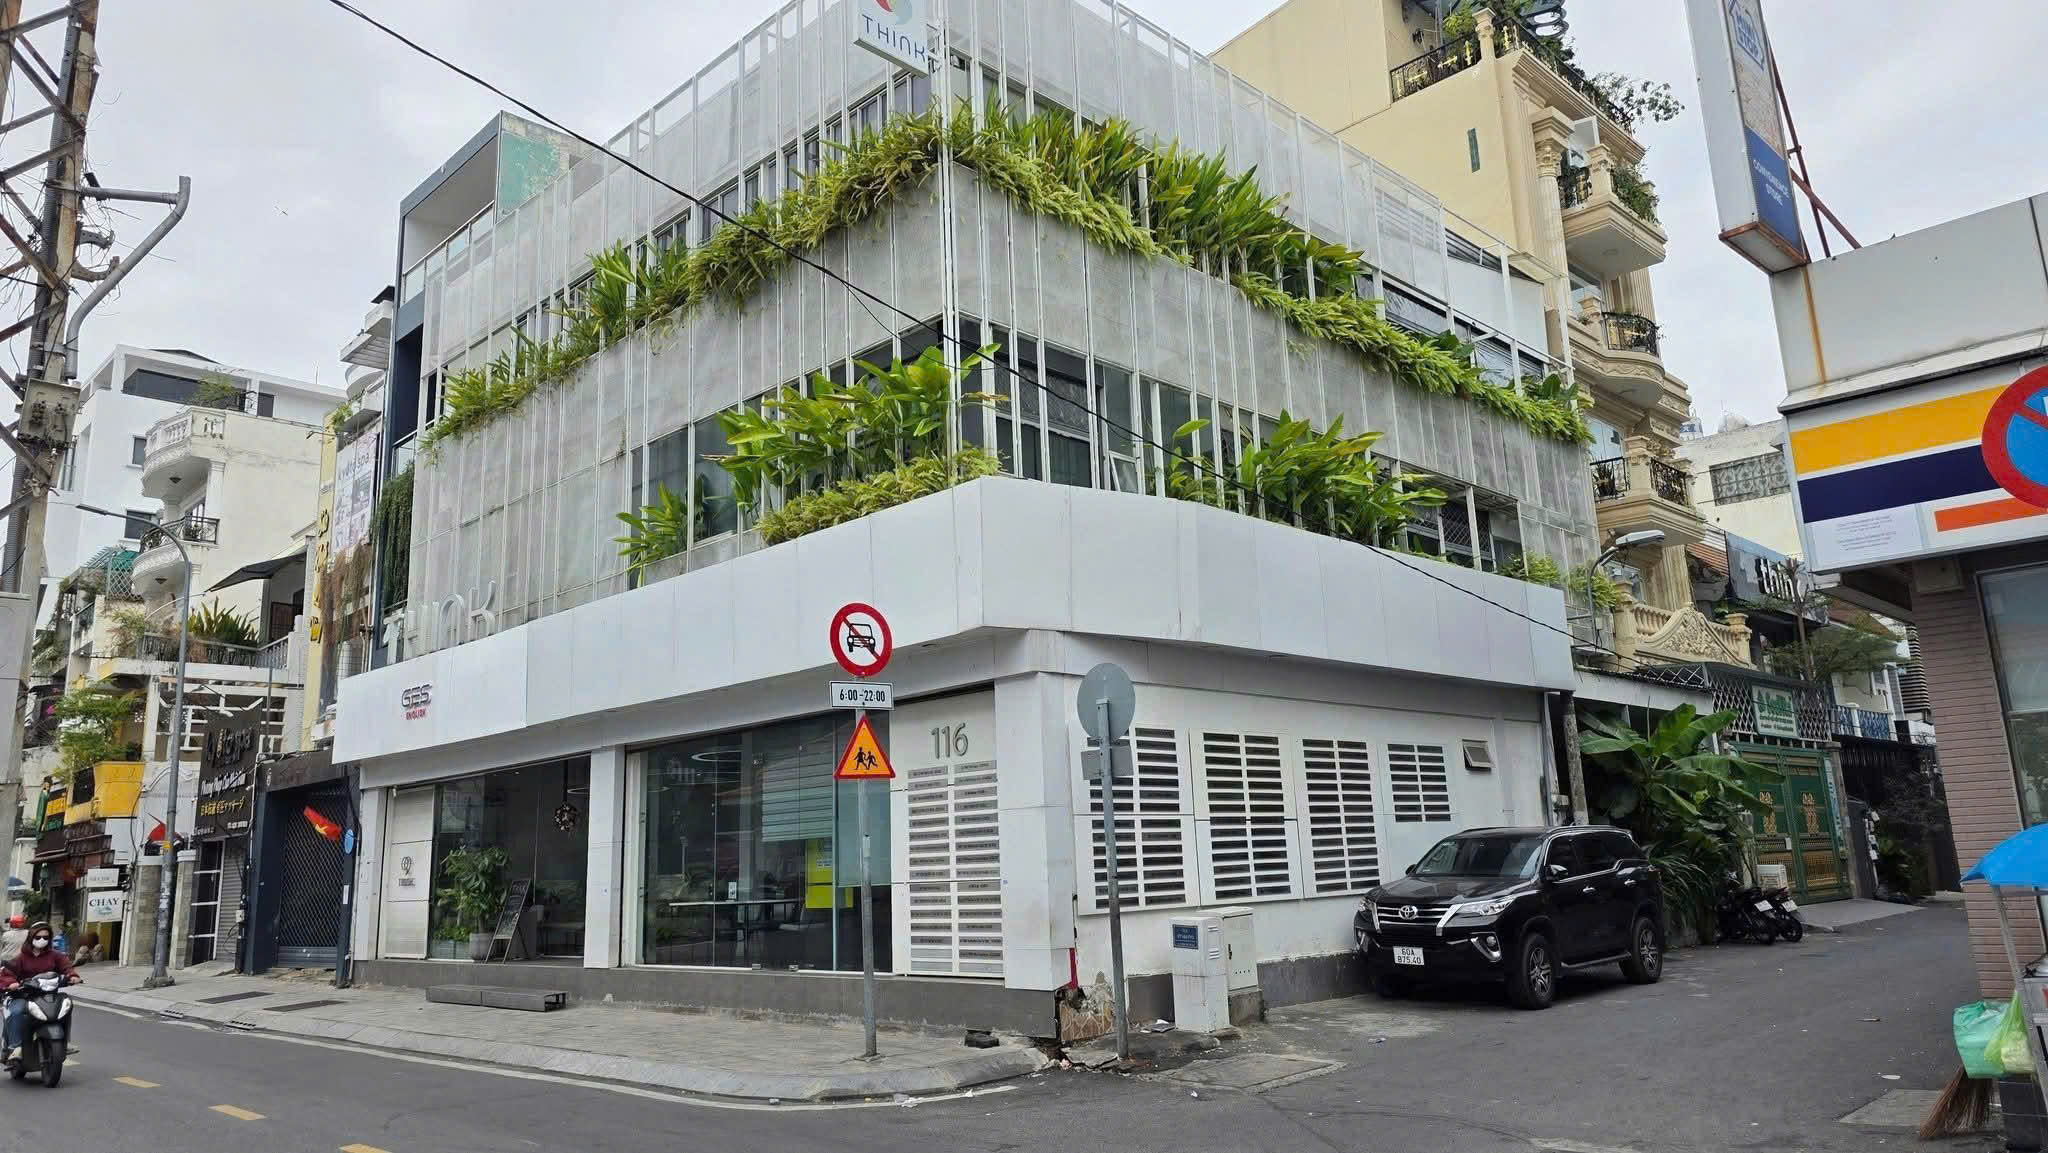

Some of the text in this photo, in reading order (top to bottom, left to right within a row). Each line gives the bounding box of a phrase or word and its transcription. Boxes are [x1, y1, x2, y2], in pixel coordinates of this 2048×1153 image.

[862, 14, 926, 62] THINK
[402, 683, 433, 709] GES
[839, 688, 886, 703] 6:00-22:00
[930, 722, 969, 760] 116
[89, 897, 119, 907] CHAY
[1401, 948, 1415, 956] 60A
